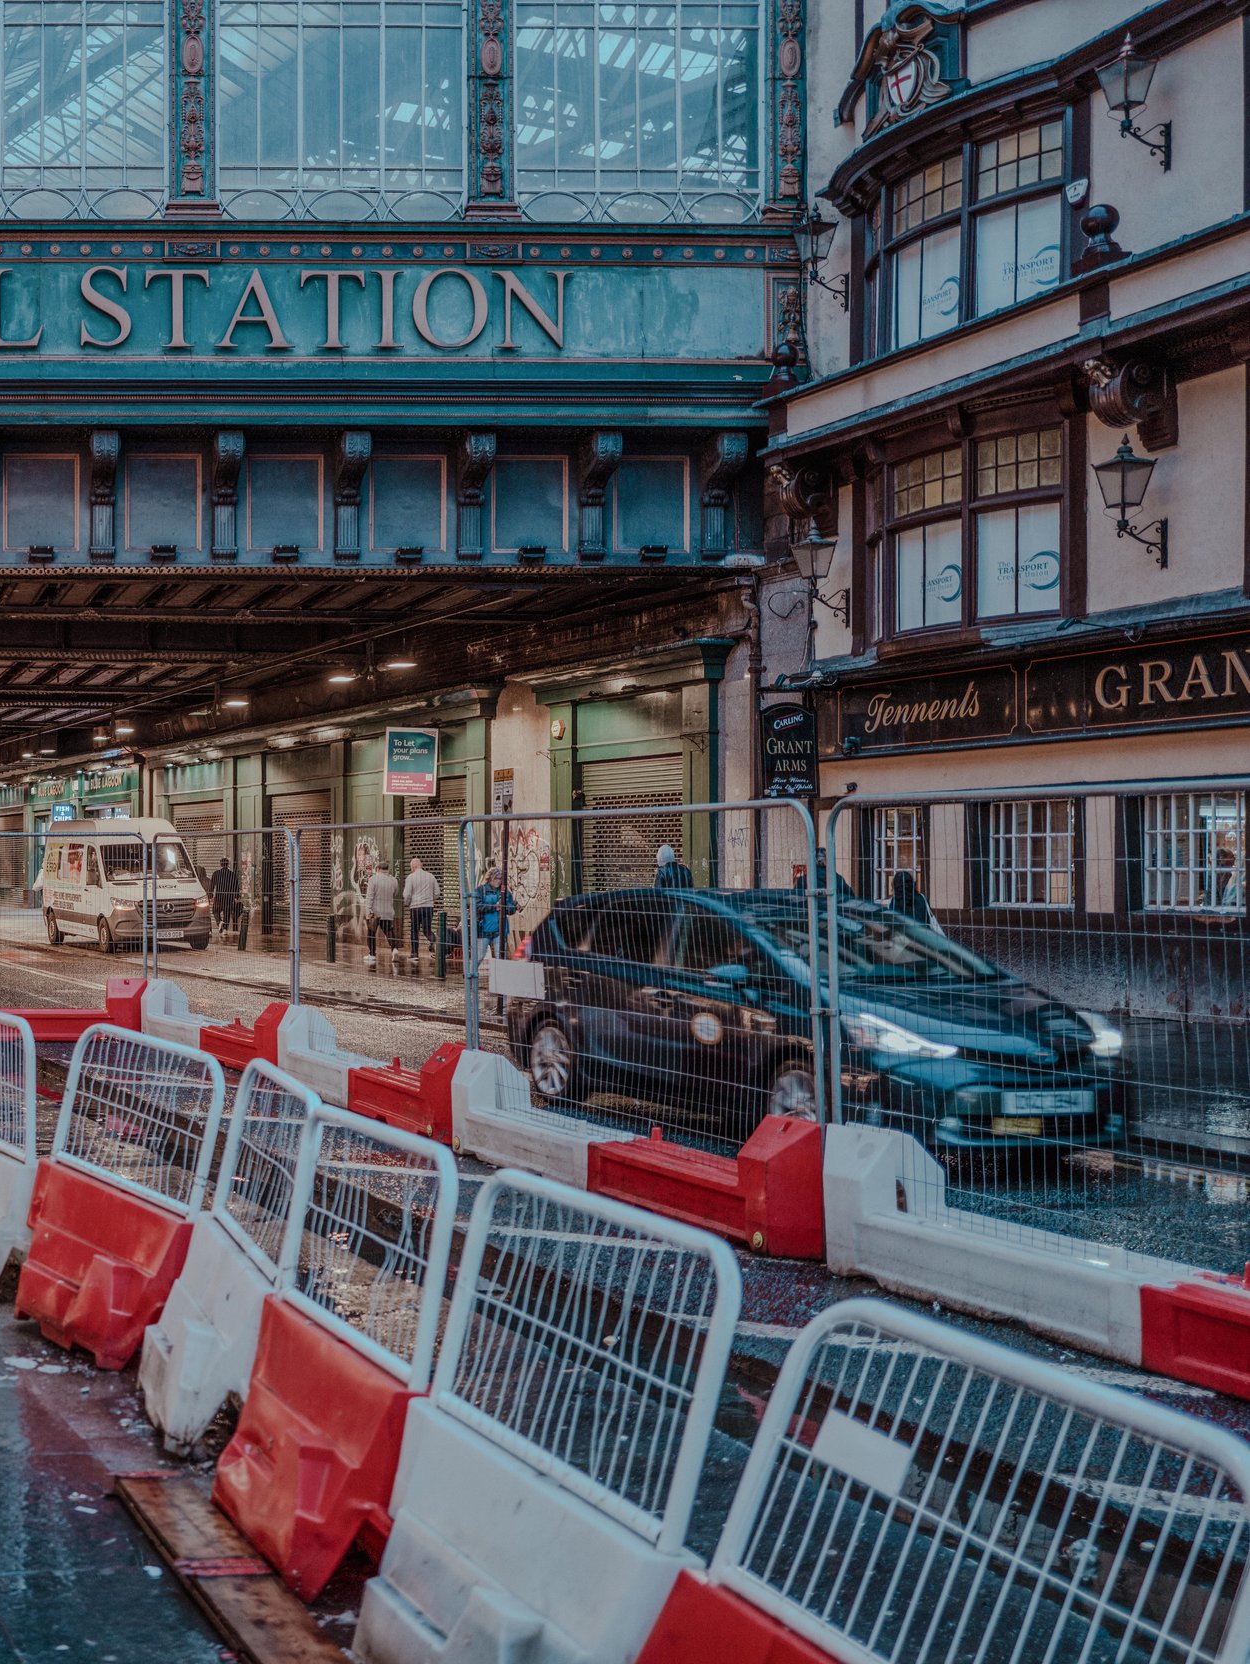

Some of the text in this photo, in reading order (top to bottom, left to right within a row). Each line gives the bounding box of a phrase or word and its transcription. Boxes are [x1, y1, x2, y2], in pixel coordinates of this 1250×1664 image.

[922, 288, 952, 305] RANSPORT
[80, 265, 574, 351] STATION
[920, 575, 953, 588] TANSPORT
[1094, 650, 1250, 710] GRAN
[774, 713, 804, 729] CARLING
[393, 747, 428, 755] your plans
[403, 739, 415, 747] Let
[766, 737, 813, 755] GRANT
[774, 759, 807, 772] ARMS
